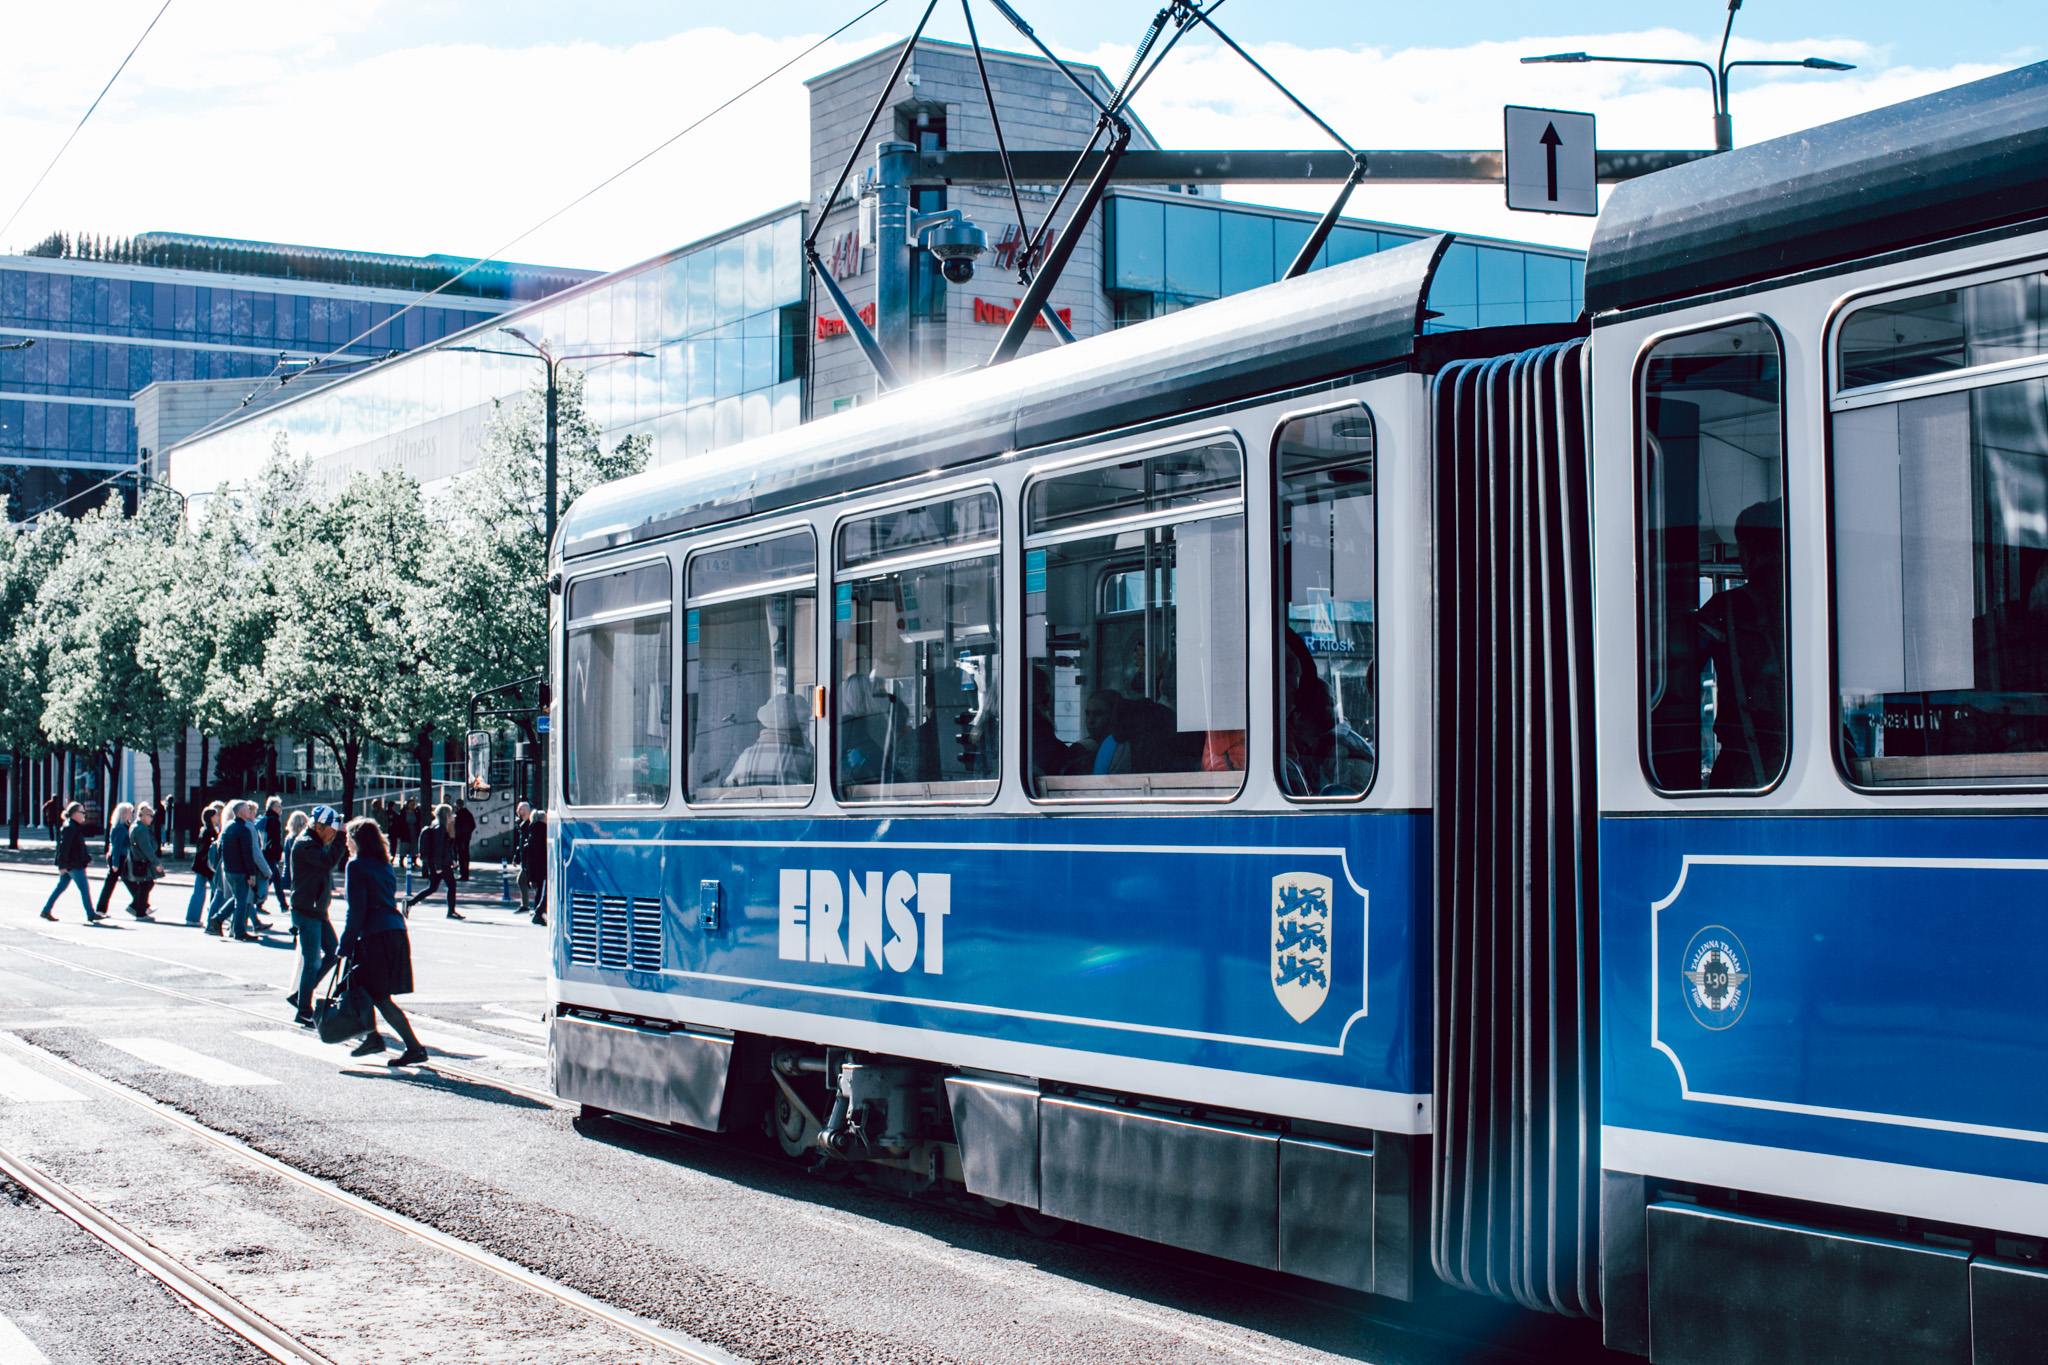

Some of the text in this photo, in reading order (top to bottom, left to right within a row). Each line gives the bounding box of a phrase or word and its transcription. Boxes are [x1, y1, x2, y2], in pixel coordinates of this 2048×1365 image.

[706, 559, 730, 571] 142
[1319, 638, 1355, 652] kiosk
[778, 868, 951, 975] ERNST
[1690, 940, 1741, 972] TALLINNA TRAMM
[1705, 972, 1727, 988] 130
[1729, 989, 1742, 1011] 2018
